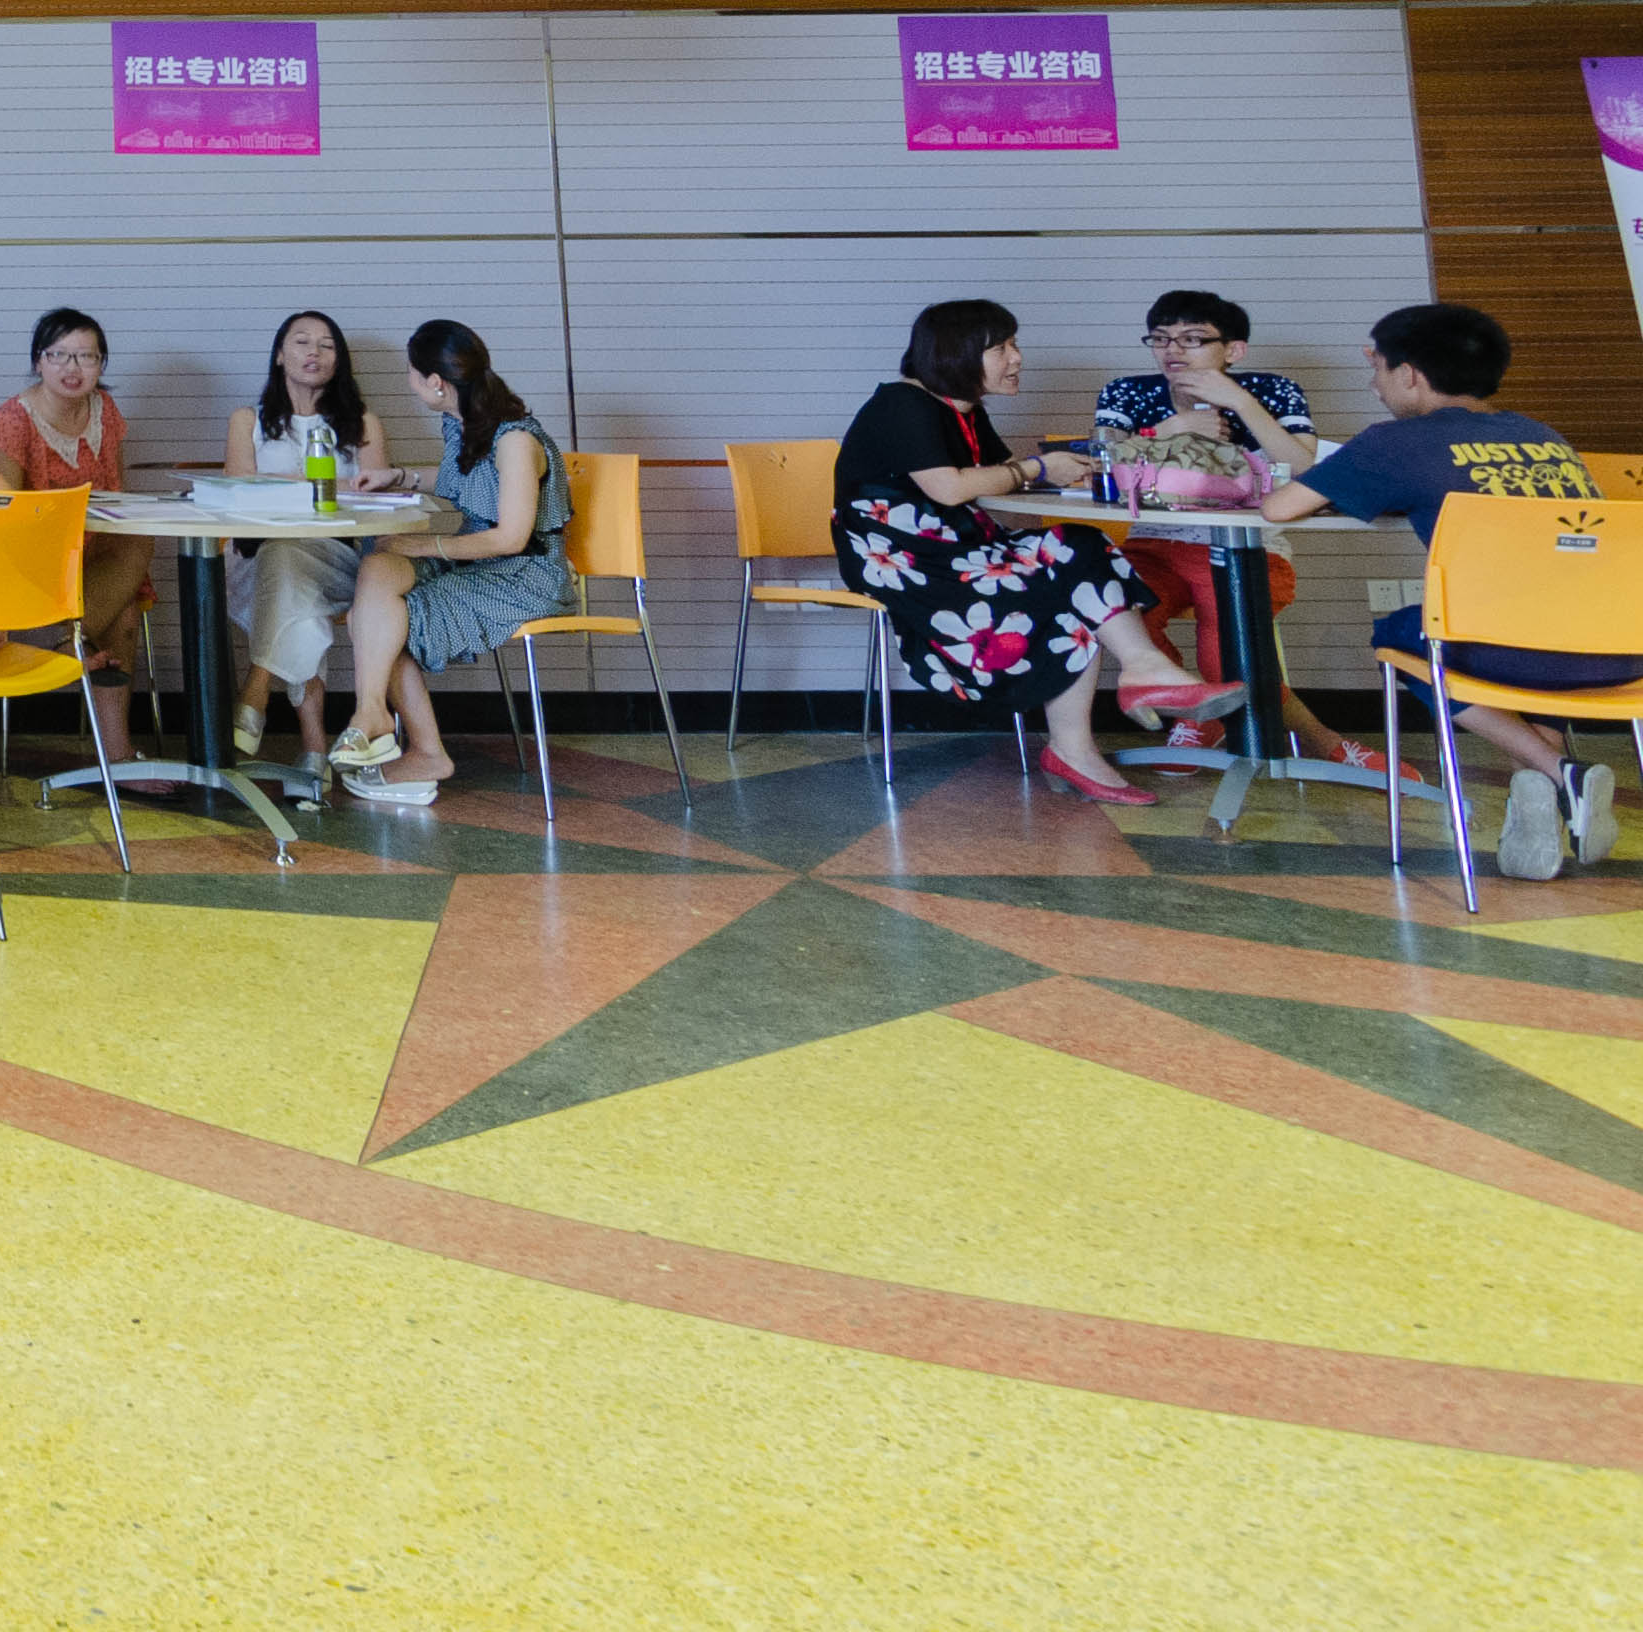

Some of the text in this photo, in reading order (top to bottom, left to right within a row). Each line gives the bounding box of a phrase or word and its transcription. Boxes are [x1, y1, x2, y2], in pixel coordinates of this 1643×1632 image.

[125, 55, 308, 86] 招生专业咨询
[914, 50, 1102, 81] 招生专业咨询
[1450, 442, 1524, 466] JUST
